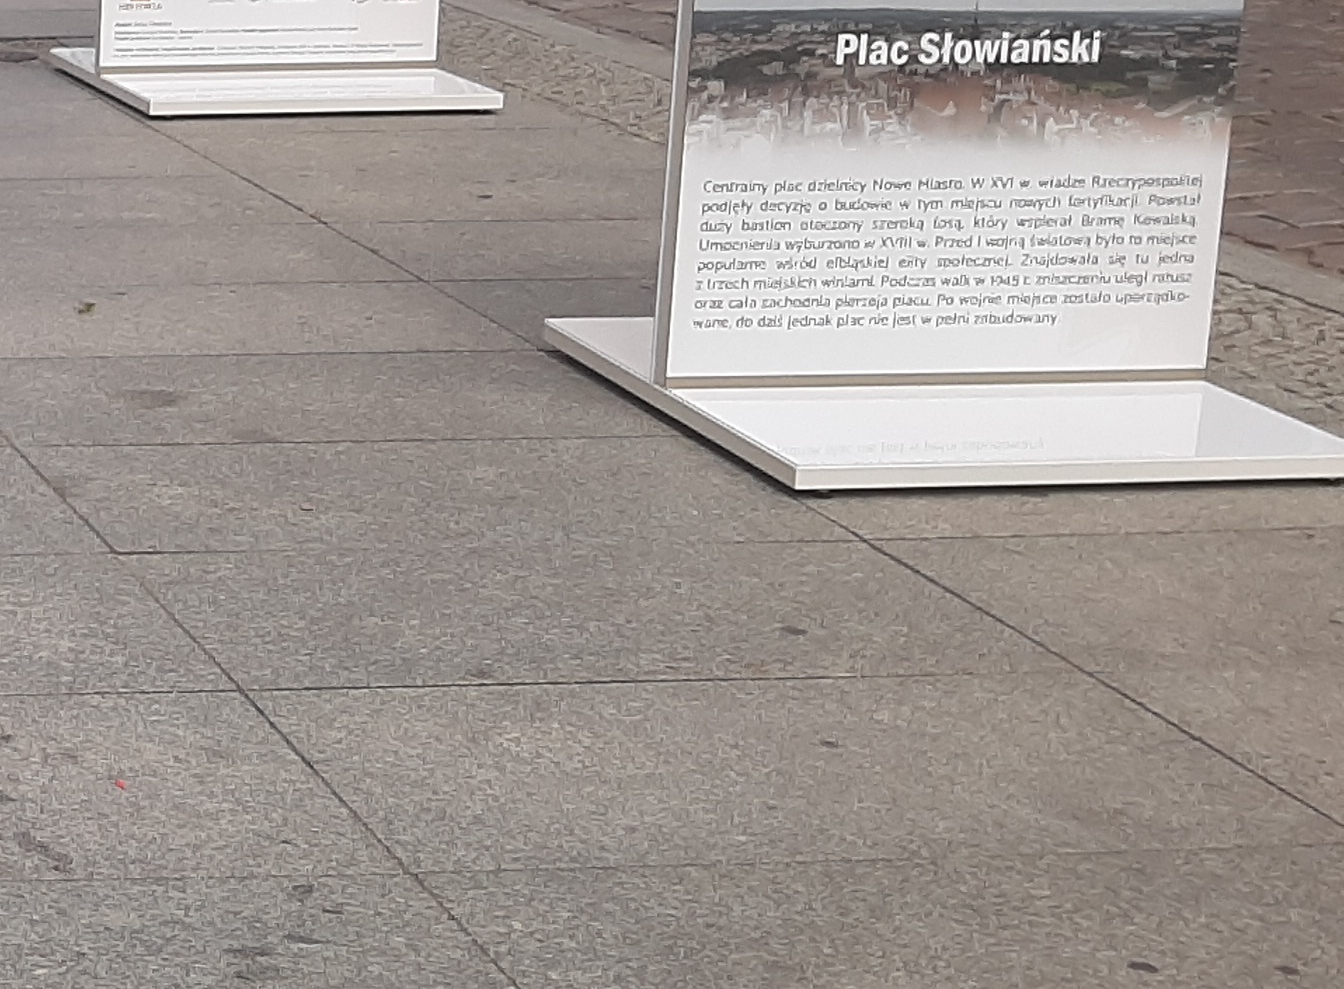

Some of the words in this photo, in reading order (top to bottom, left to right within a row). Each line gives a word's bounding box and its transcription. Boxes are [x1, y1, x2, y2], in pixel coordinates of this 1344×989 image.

[834, 32, 910, 66] Plac
[916, 28, 1102, 66] Słowiański
[773, 180, 803, 196] plac
[991, 176, 1014, 189] XVI
[818, 201, 828, 211] o
[973, 214, 1008, 231] który
